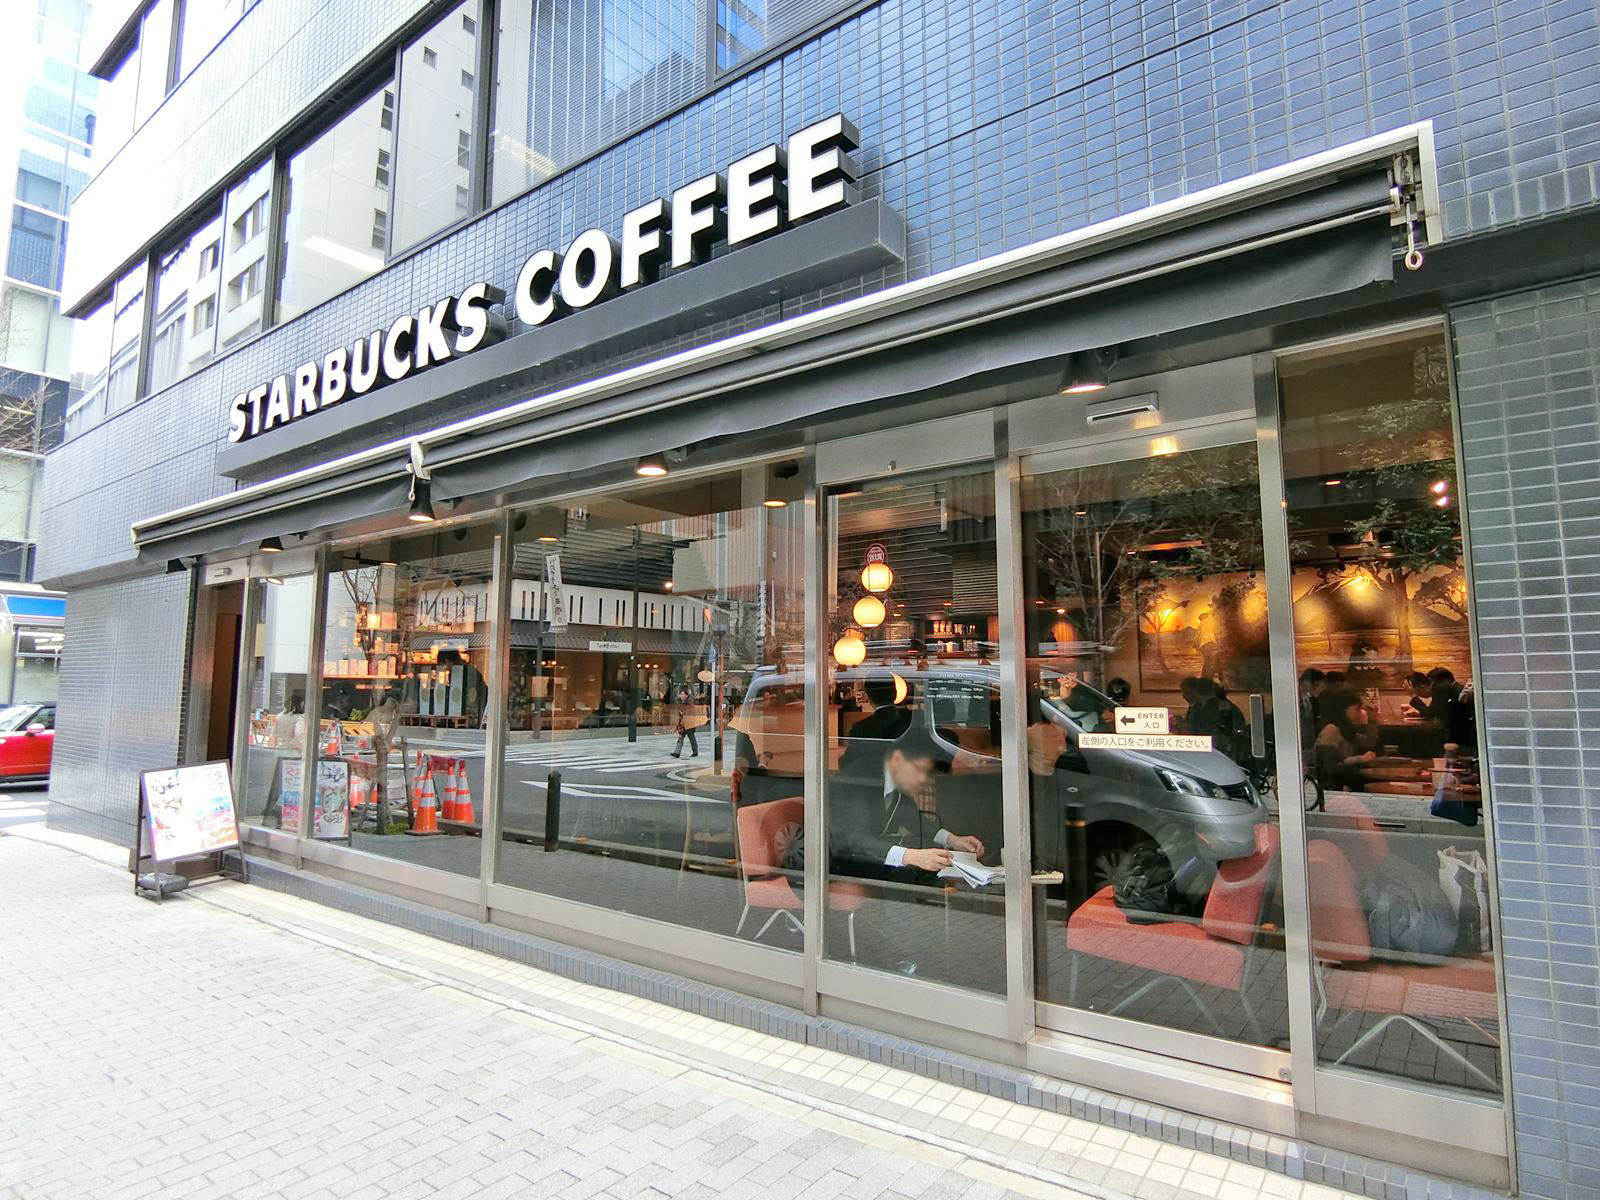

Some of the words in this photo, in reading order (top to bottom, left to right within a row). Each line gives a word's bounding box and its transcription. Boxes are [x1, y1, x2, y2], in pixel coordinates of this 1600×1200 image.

[227, 282, 488, 443] STARBUCKS
[515, 112, 849, 326] COFFEE
[1138, 712, 1164, 720] ENTER
[1081, 736, 1209, 749] 左側の入口をご利用ください。
